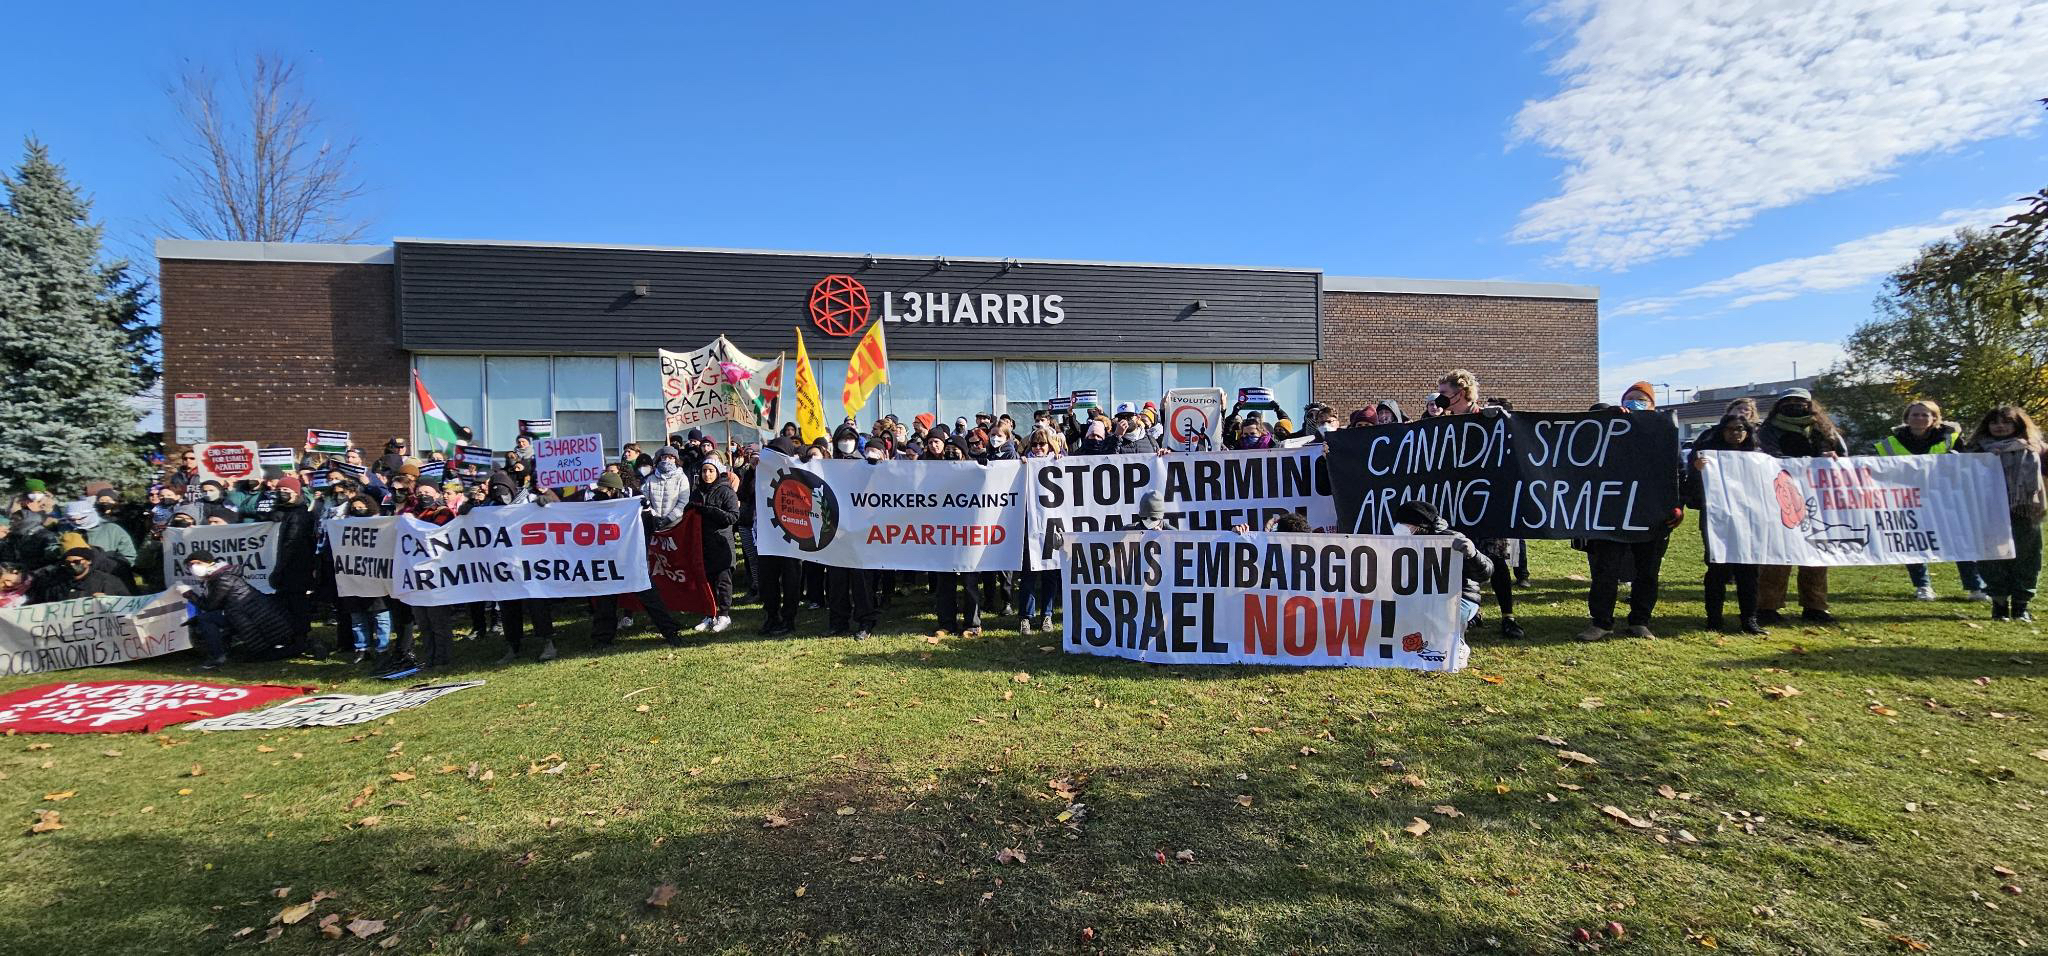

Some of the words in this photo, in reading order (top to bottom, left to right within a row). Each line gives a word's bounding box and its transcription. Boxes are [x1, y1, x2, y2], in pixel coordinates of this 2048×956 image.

[883, 291, 1065, 325] L3HARRIS
[660, 340, 728, 376] BREAK
[665, 389, 722, 415] GAZA
[666, 411, 700, 428] FREE
[703, 403, 753, 426] PALTINE
[538, 436, 597, 458] L3HARRIS
[1367, 418, 1513, 476] CANADA:
[1527, 418, 1632, 468] STOP
[557, 457, 582, 467] ARMS
[540, 467, 599, 487] GENOCIDE
[1038, 462, 1151, 509] STOP
[1807, 466, 1873, 489] LABOUR
[781, 496, 794, 505] For
[781, 504, 820, 518] Palestine
[850, 492, 938, 508] WORKERS
[942, 492, 1019, 508] AGAINST
[1510, 479, 1650, 531] ISRAEL
[1823, 489, 1888, 510] AGAINST
[1892, 487, 1923, 508] THE
[781, 514, 808, 526] Canada
[1875, 509, 1918, 531] ARMS
[341, 526, 379, 548] FREE
[401, 525, 513, 558] CANADA
[520, 522, 621, 546] STOP
[866, 524, 1006, 546] APARTHEID
[1885, 530, 1940, 553] TRADE
[335, 554, 394, 579] ALESTIN
[401, 560, 515, 591] ARMING
[522, 558, 625, 581] ISRAEL
[1070, 540, 1163, 587] ARMS
[1174, 542, 1378, 594] EMBARGO
[1391, 545, 1452, 595] ON
[30, 615, 131, 647] PALESTINE
[1070, 588, 1229, 654] ISRAEL
[1243, 592, 1397, 659] NOW!
[0, 644, 89, 676] OCCUPATION
[92, 642, 108, 664] IS
[110, 642, 122, 662] A
[123, 630, 176, 660] CRIME
